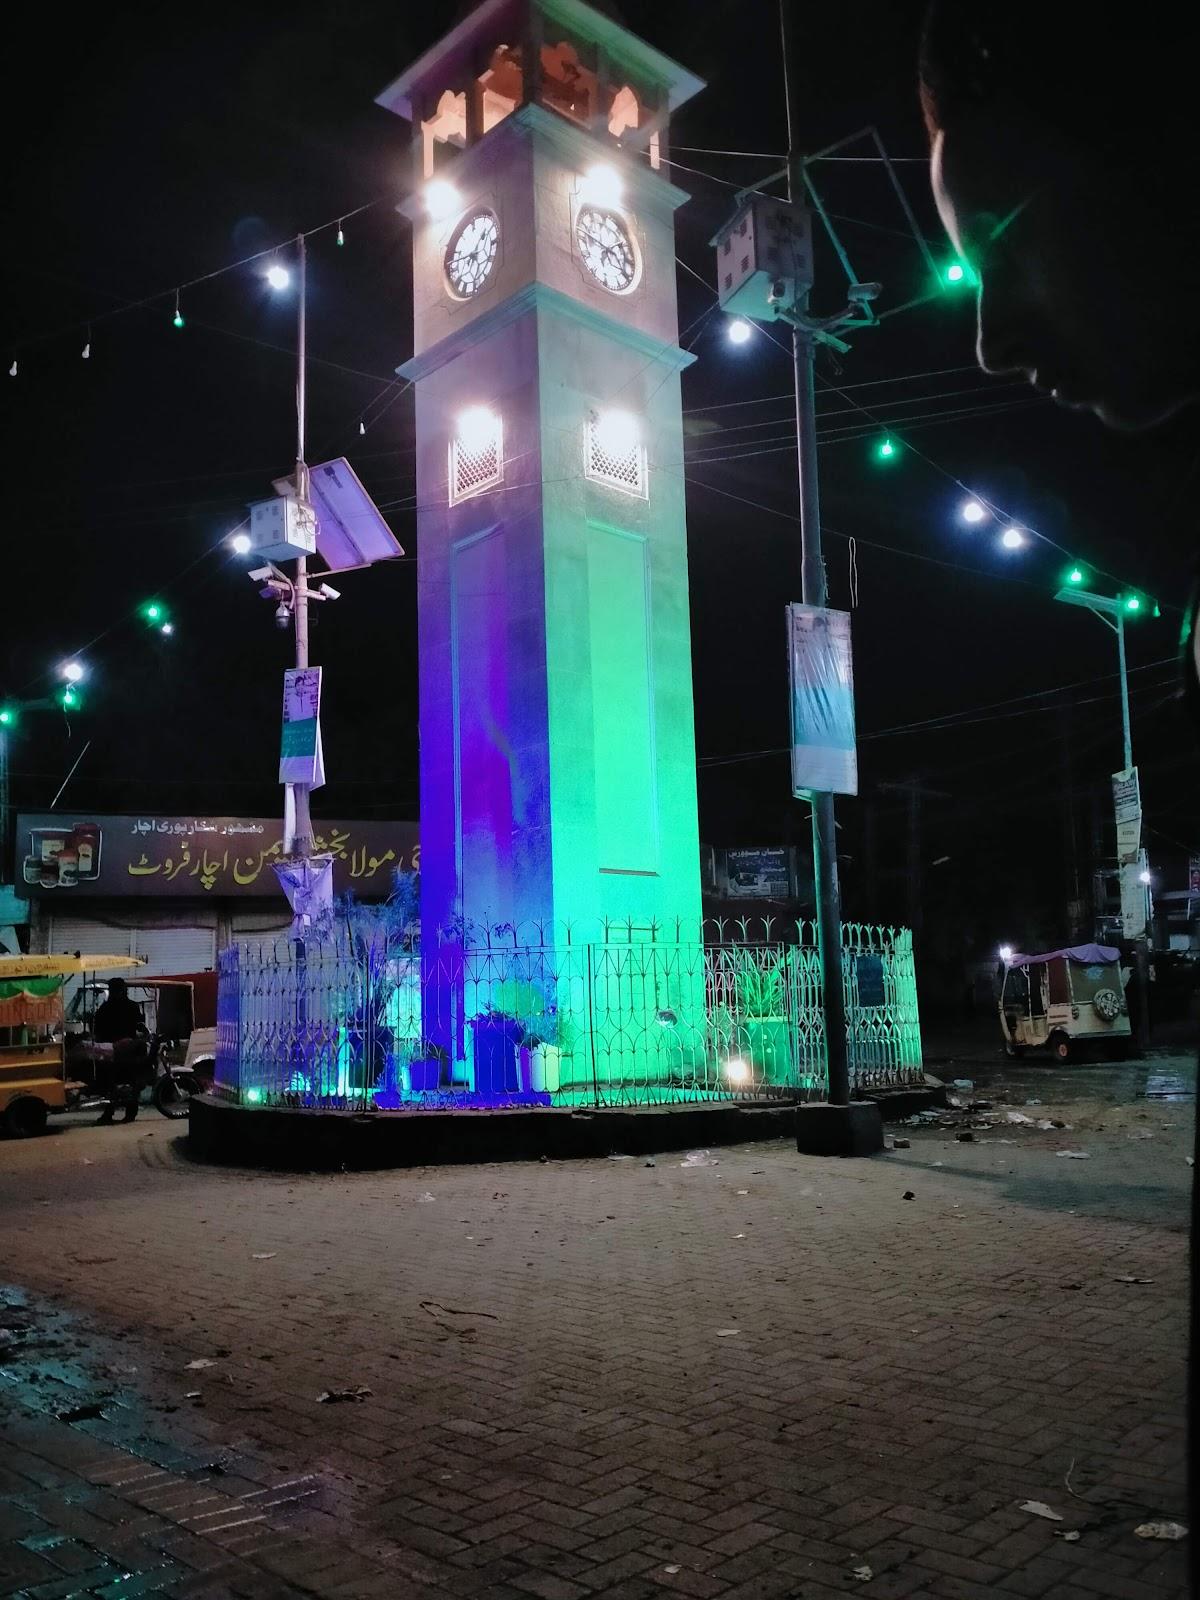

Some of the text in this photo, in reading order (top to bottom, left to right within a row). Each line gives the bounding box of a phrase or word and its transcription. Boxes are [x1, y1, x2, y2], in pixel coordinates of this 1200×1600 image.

[130, 819, 156, 837] اچار
[128, 841, 191, 881] فروٹ
[190, 849, 228, 890] اچار
[233, 840, 284, 885] یمن
[350, 845, 395, 878] مولا
